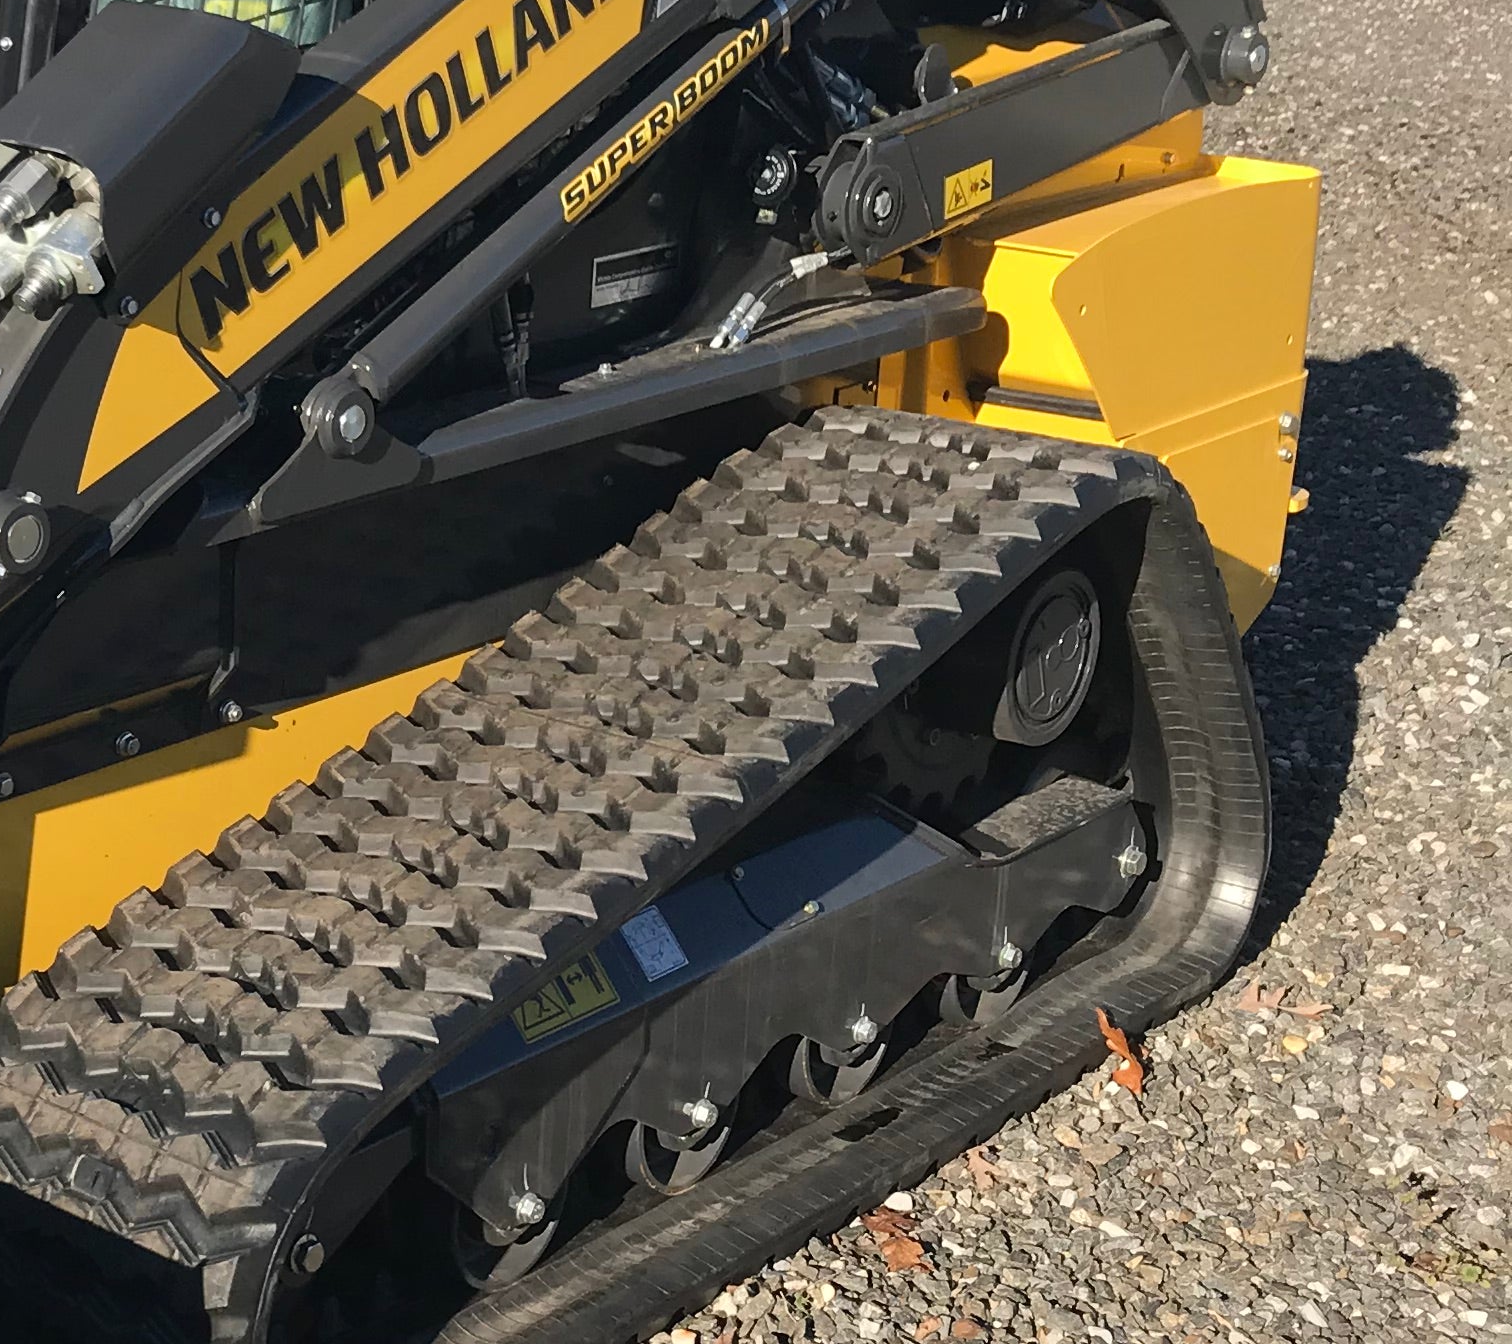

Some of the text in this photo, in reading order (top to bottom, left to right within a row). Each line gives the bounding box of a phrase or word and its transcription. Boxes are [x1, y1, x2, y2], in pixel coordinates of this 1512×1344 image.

[562, 18, 769, 220] SUPER BOOM
[188, 153, 348, 341] NEW
